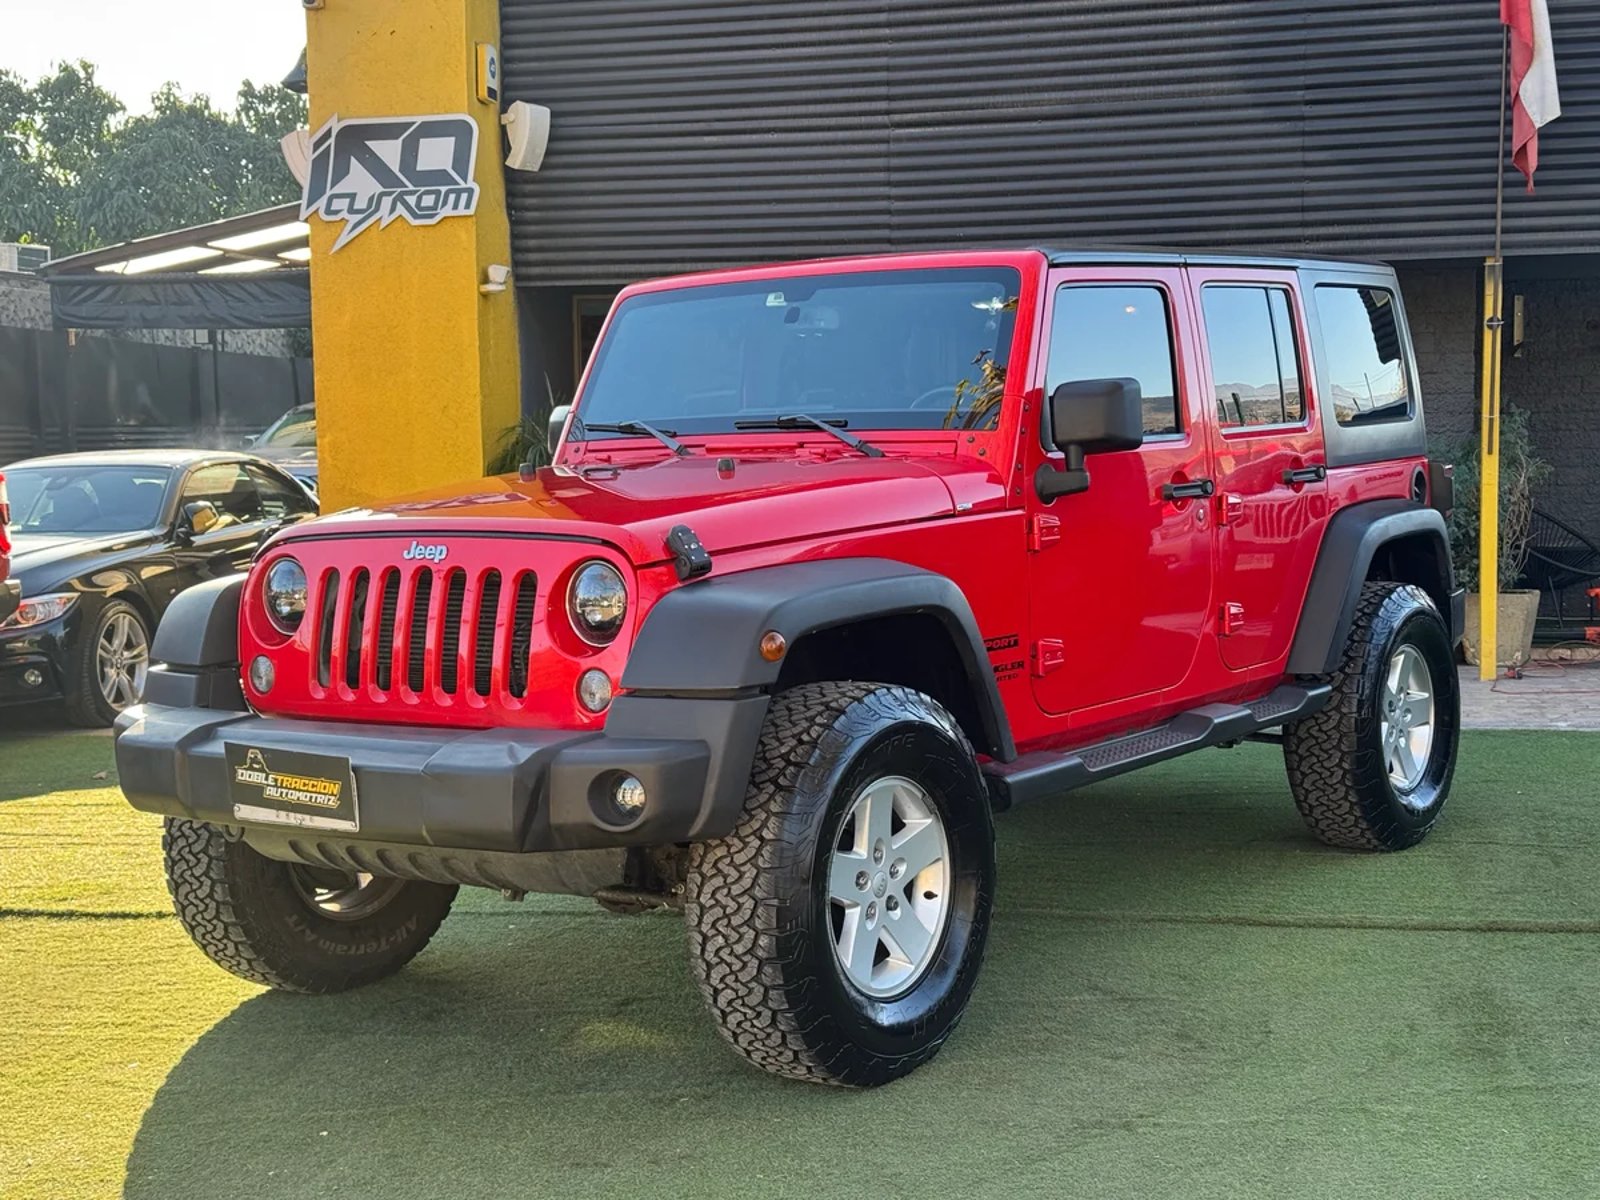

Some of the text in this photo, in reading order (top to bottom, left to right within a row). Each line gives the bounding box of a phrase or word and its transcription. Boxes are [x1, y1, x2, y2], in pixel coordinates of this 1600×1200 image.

[403, 540, 447, 563] Jeep
[266, 786, 337, 806] AUTOMOTRIZ
[318, 912, 417, 956] All-Terrain
